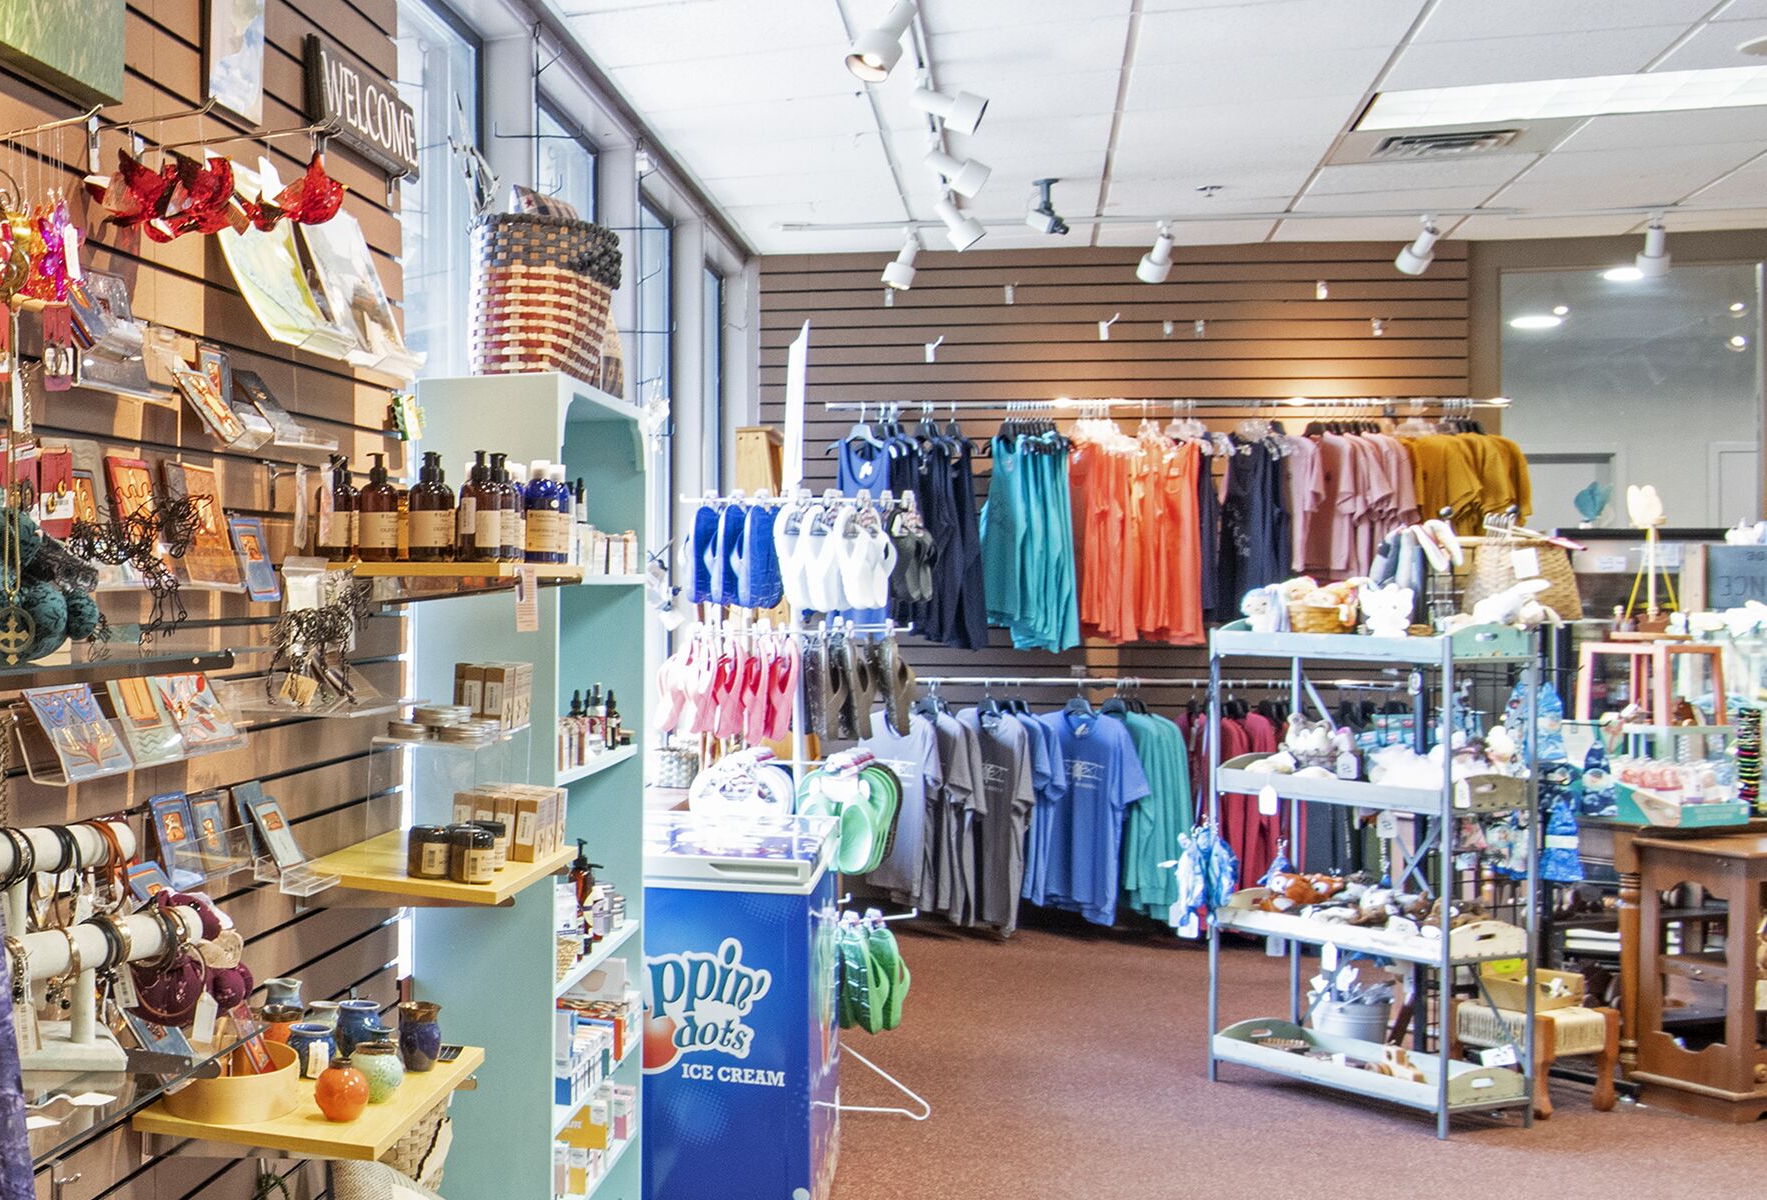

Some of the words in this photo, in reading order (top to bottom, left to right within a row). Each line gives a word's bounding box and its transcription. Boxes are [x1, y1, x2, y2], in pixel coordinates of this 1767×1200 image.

[320, 50, 418, 167] WELCOME
[643, 944, 765, 1020] ppin'
[674, 1015, 748, 1050] dots
[681, 1063, 714, 1081] ICE
[717, 1066, 786, 1088] CREAM
